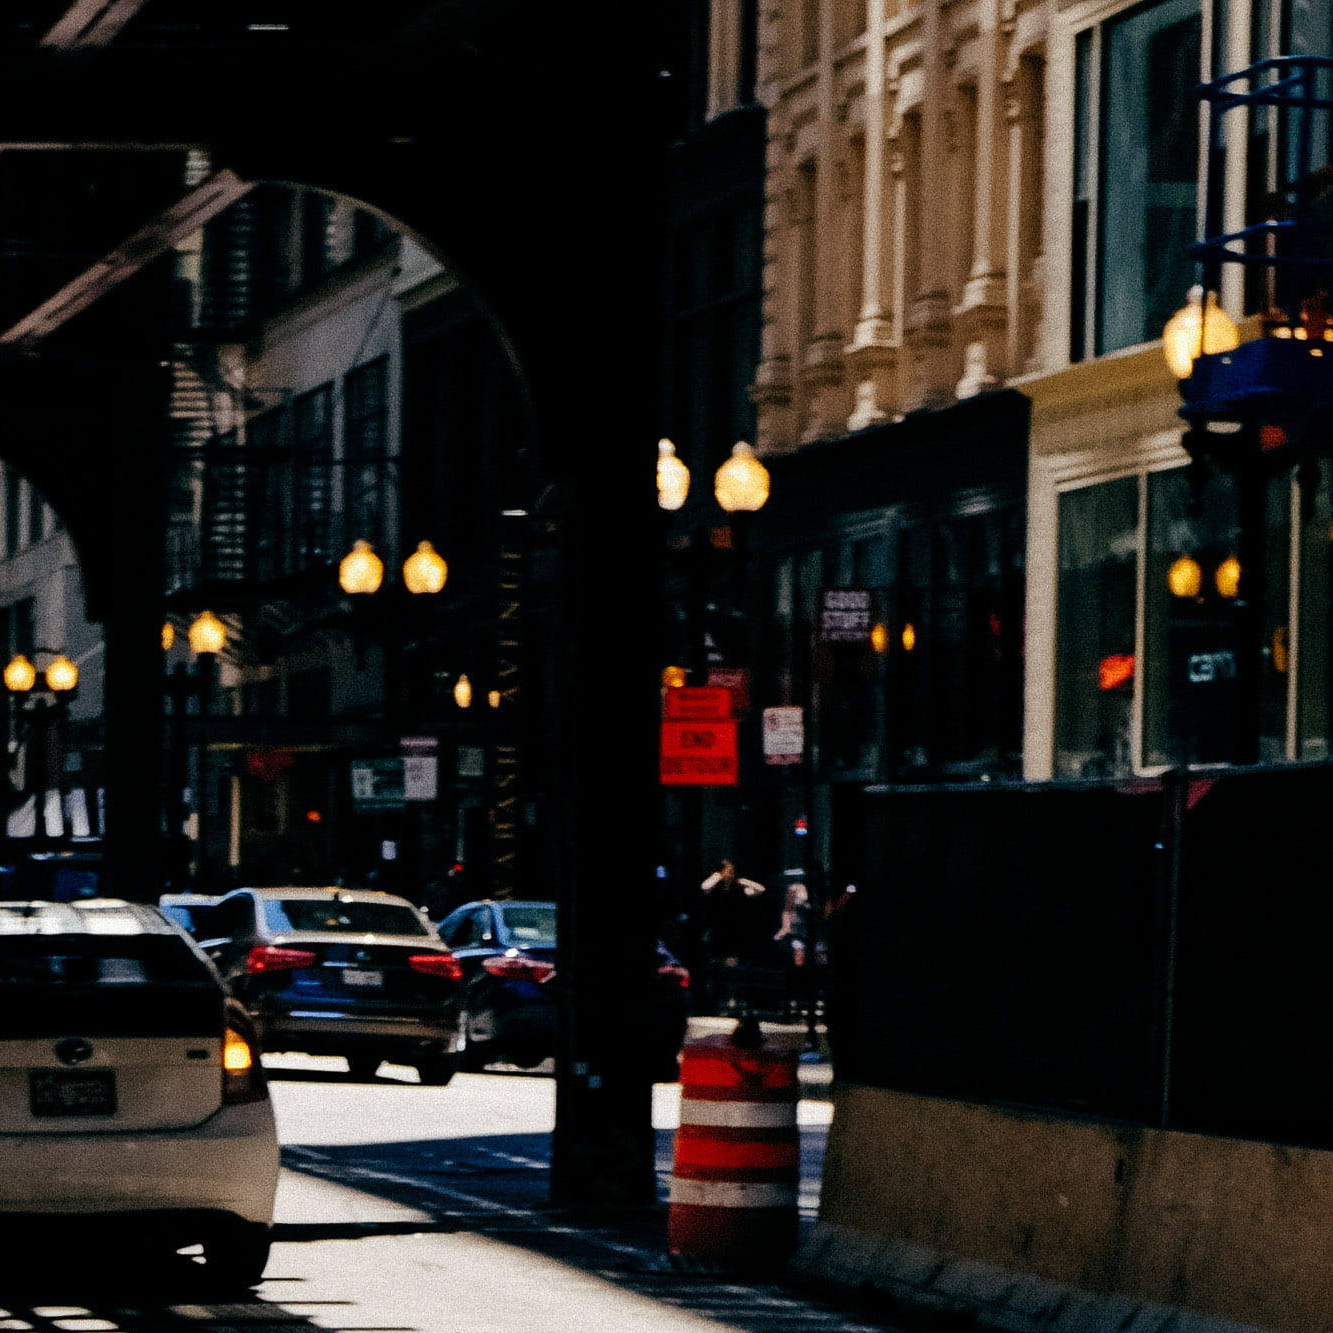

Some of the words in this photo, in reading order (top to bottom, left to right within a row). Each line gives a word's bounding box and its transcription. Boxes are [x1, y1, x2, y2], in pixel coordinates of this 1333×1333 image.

[498, 545, 521, 706] AVENUE
[680, 731, 715, 749] END
[662, 756, 733, 774] DETOUR
